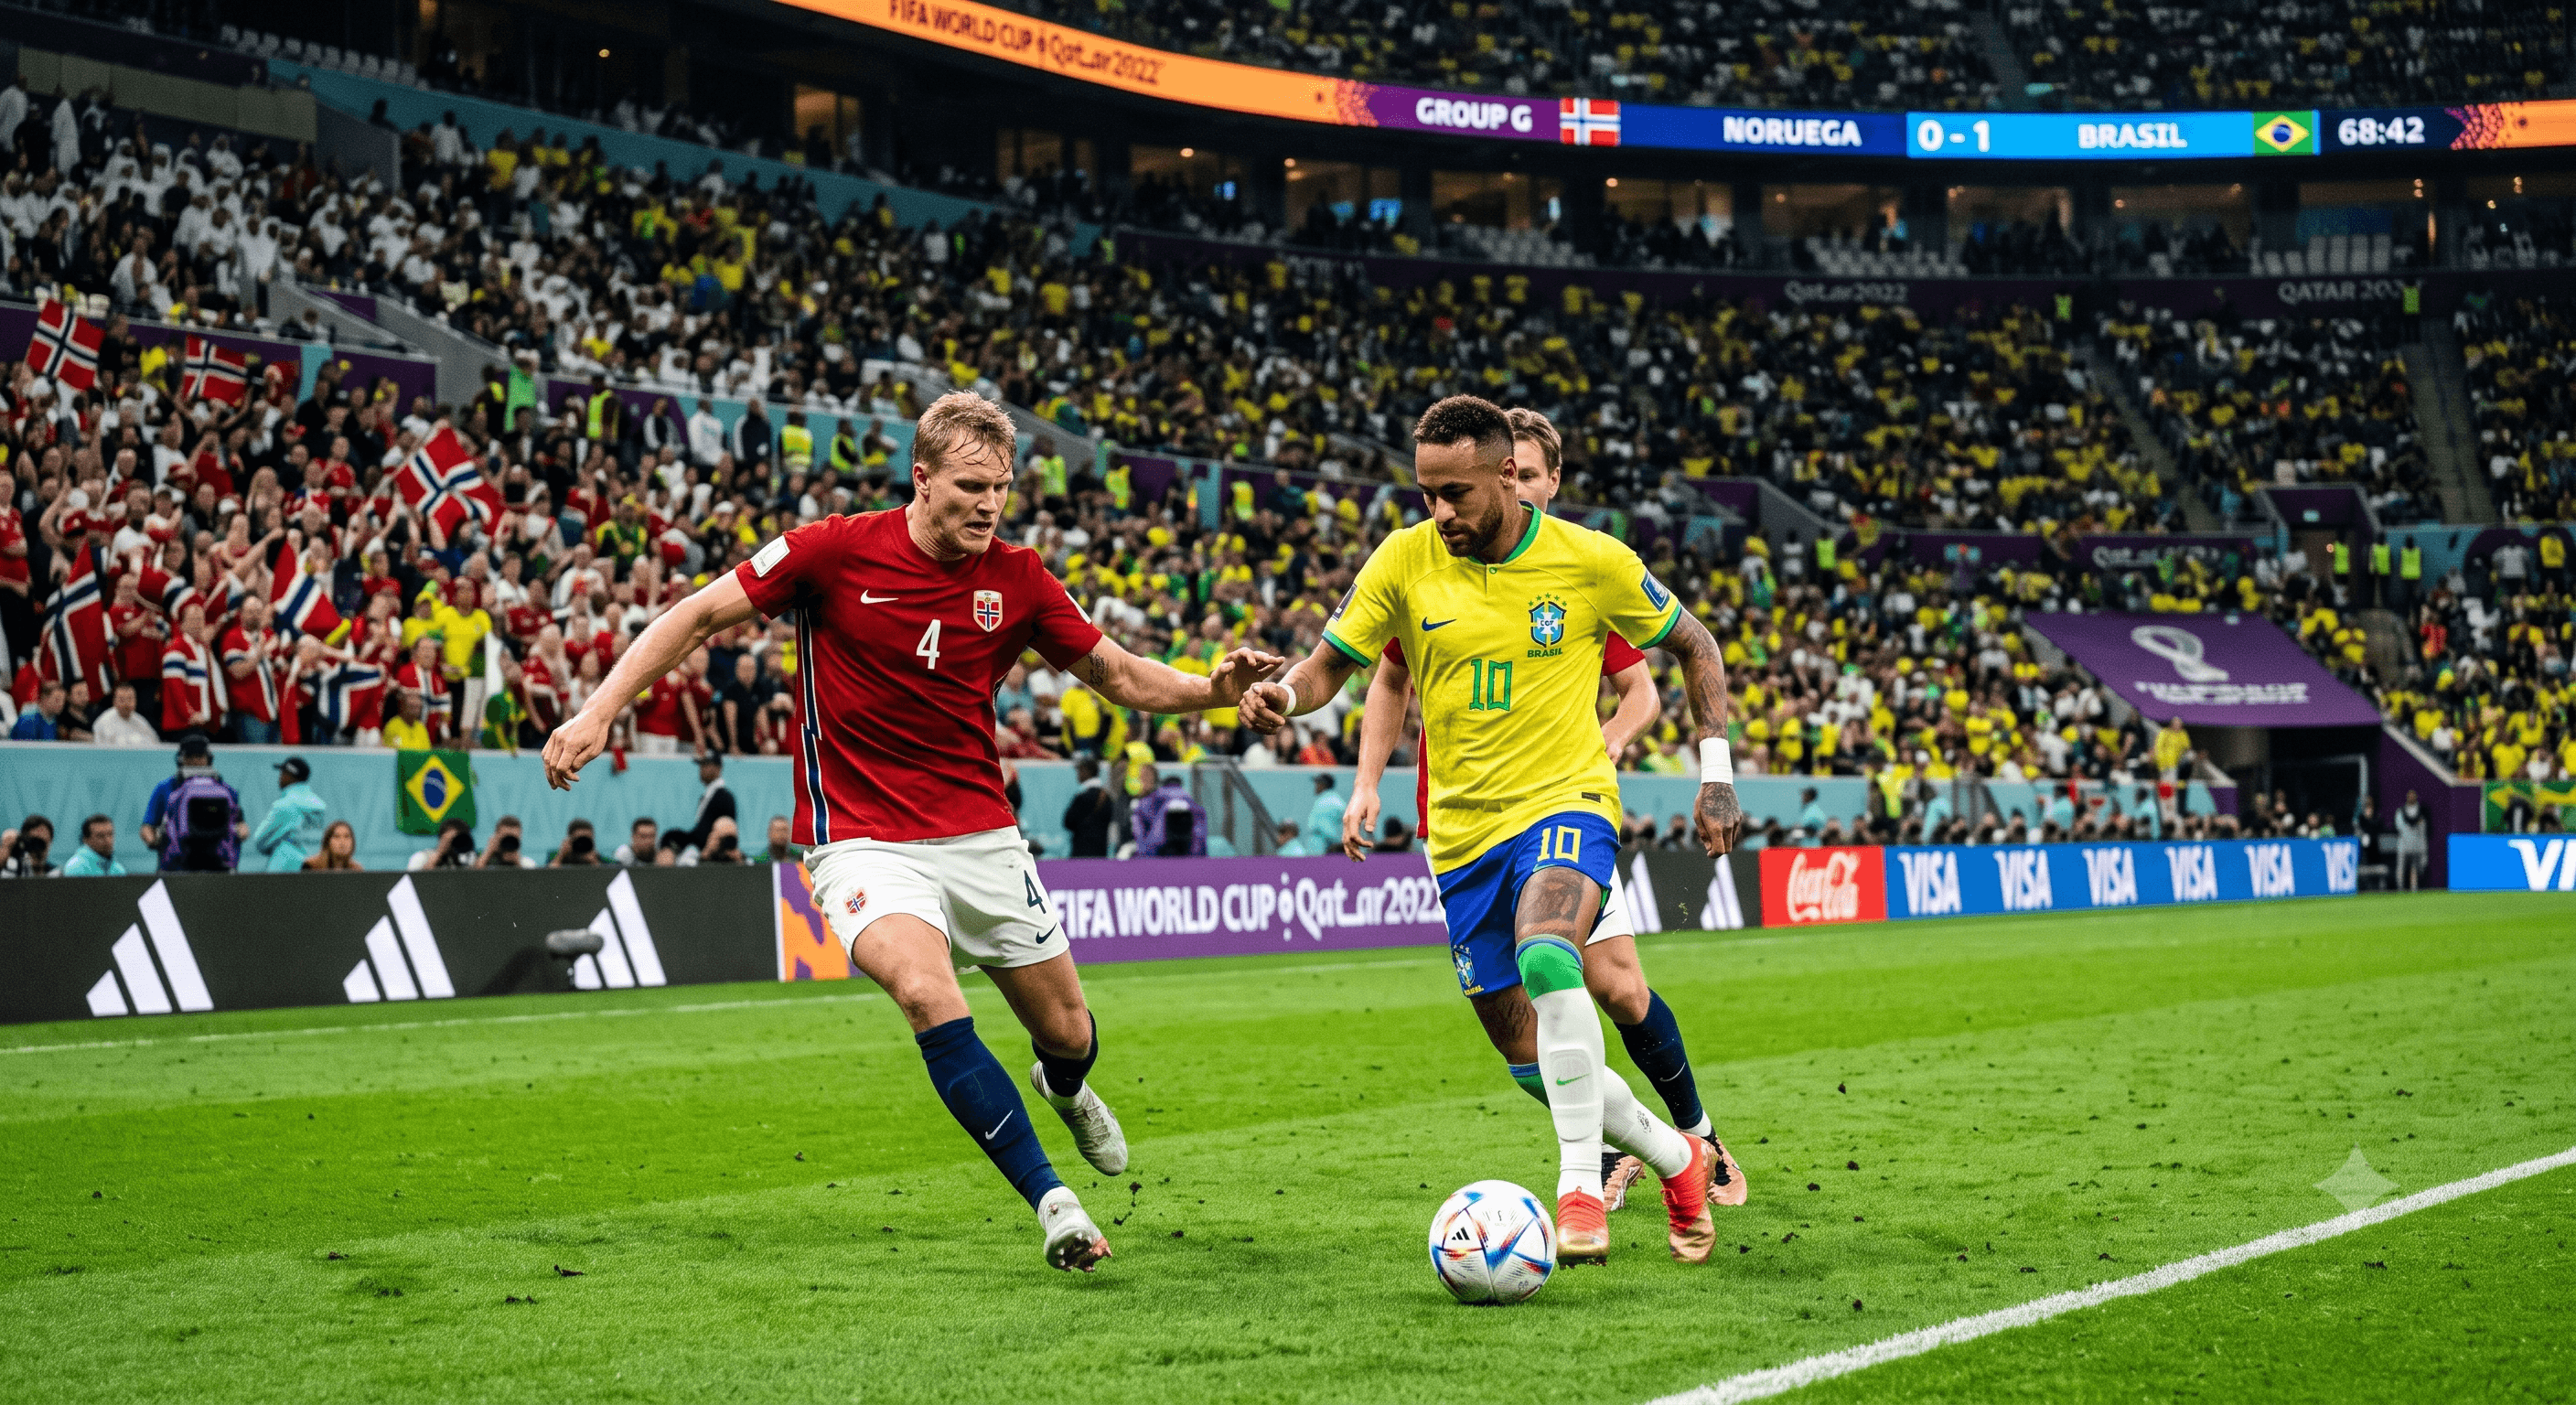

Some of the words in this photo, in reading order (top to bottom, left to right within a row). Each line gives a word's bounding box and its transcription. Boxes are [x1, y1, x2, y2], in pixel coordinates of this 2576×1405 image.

[888, 0, 929, 26] FIFA
[931, 5, 996, 45] WORLD
[998, 22, 1034, 51] CUP
[1416, 97, 1508, 130] GROUP
[1510, 104, 1533, 133] G
[1723, 116, 1862, 146] NORUEGA
[2338, 116, 2425, 145] 68:42
[2078, 123, 2187, 149] BRASIL
[2277, 281, 2356, 306] QATAR
[2359, 279, 2410, 300] 202
[917, 619, 941, 670] 4
[1527, 648, 1563, 658] BRASIL
[1469, 658, 1513, 712] 10
[1537, 825, 1582, 863] 10
[1024, 870, 1046, 914] 4
[1897, 850, 1962, 915] VISA
[1992, 849, 2053, 910] VISA
[2081, 846, 2139, 906] VISA
[2164, 844, 2218, 902] VISA
[2244, 842, 2295, 898] VISA
[1049, 889, 1115, 939] FIFA
[1113, 885, 1219, 937] WORLD
[1222, 883, 1277, 932] CUP
